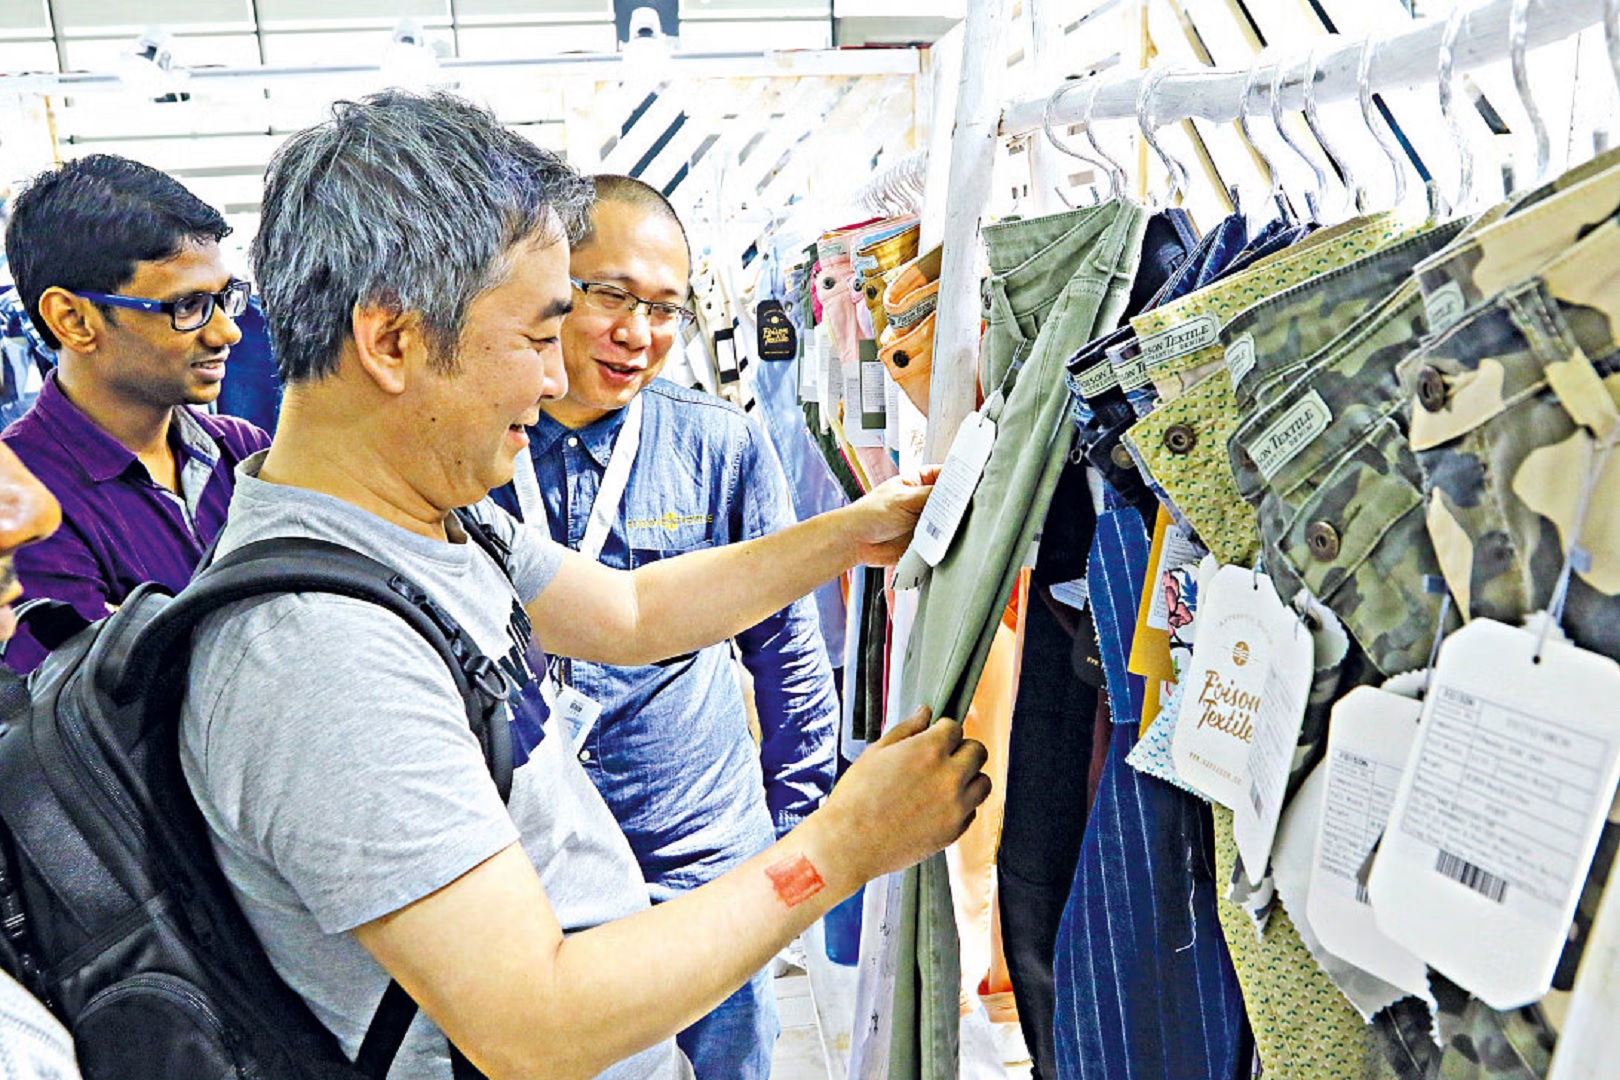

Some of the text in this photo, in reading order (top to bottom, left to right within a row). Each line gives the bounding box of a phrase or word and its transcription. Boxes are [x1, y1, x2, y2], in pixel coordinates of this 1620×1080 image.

[1165, 324, 1209, 348] TEXTILE
[1270, 407, 1315, 449] TEXTILE
[1198, 670, 1261, 713] Foison
[1197, 698, 1253, 744] Textile
